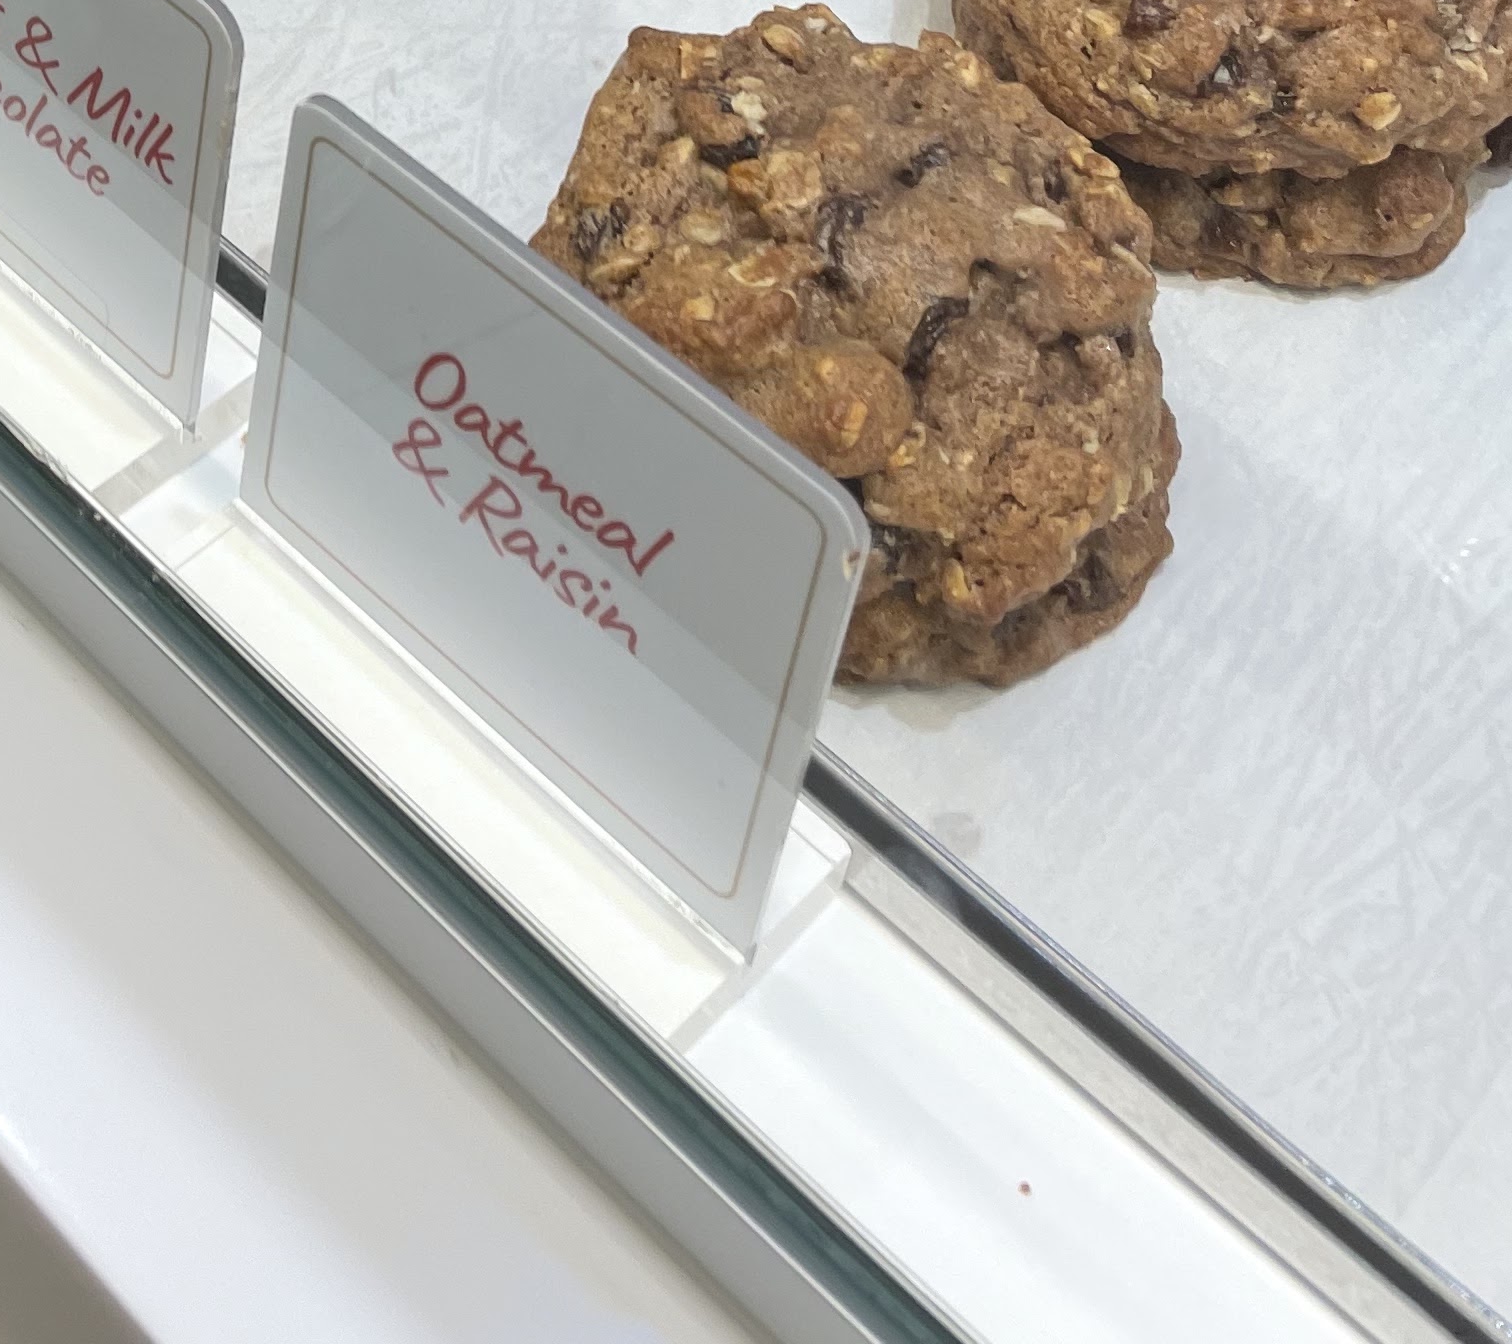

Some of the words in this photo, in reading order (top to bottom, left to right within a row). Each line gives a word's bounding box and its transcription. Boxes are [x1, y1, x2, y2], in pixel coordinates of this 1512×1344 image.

[15, 16, 59, 96] &
[67, 66, 174, 184] Milk
[392, 417, 448, 507] &
[459, 476, 638, 657] Raisin
[414, 352, 674, 577] Oatmeal
